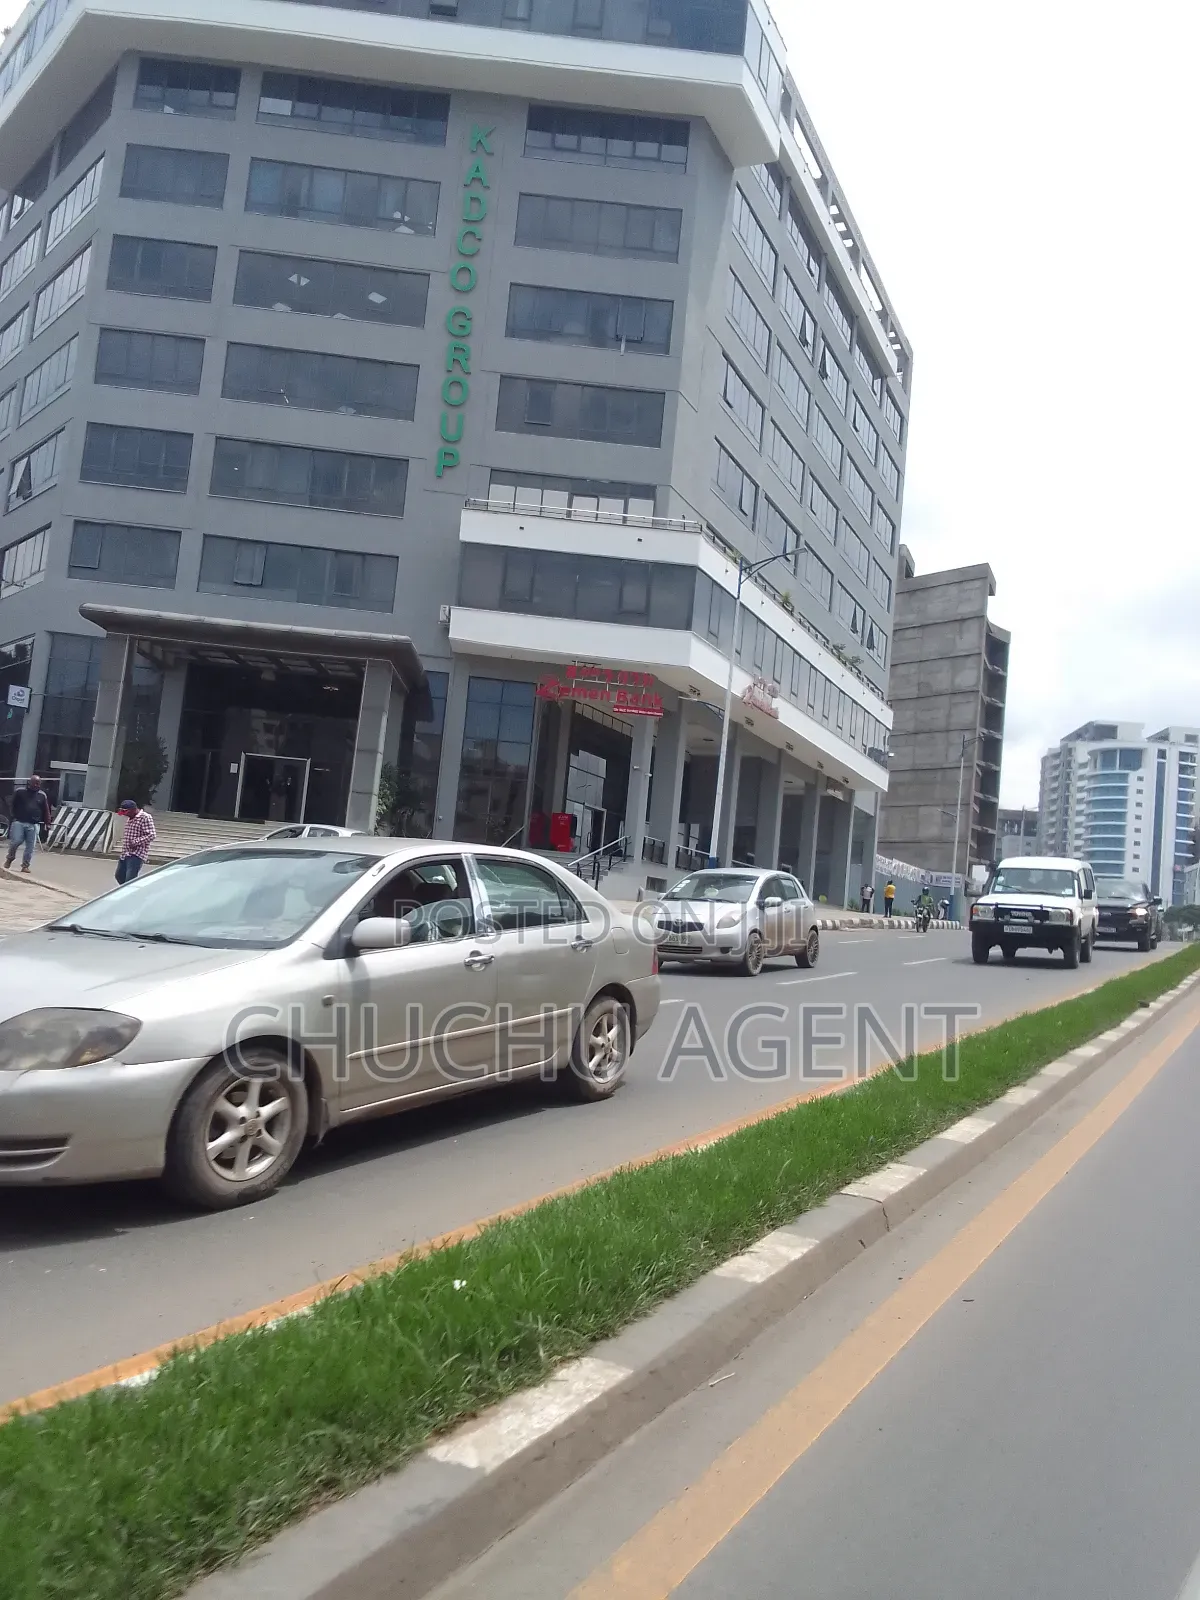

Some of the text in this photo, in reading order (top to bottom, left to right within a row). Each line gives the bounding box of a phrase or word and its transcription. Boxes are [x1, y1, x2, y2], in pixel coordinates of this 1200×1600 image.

[435, 123, 496, 478] KADCO GROUP
[616, 689, 663, 706] Bank
